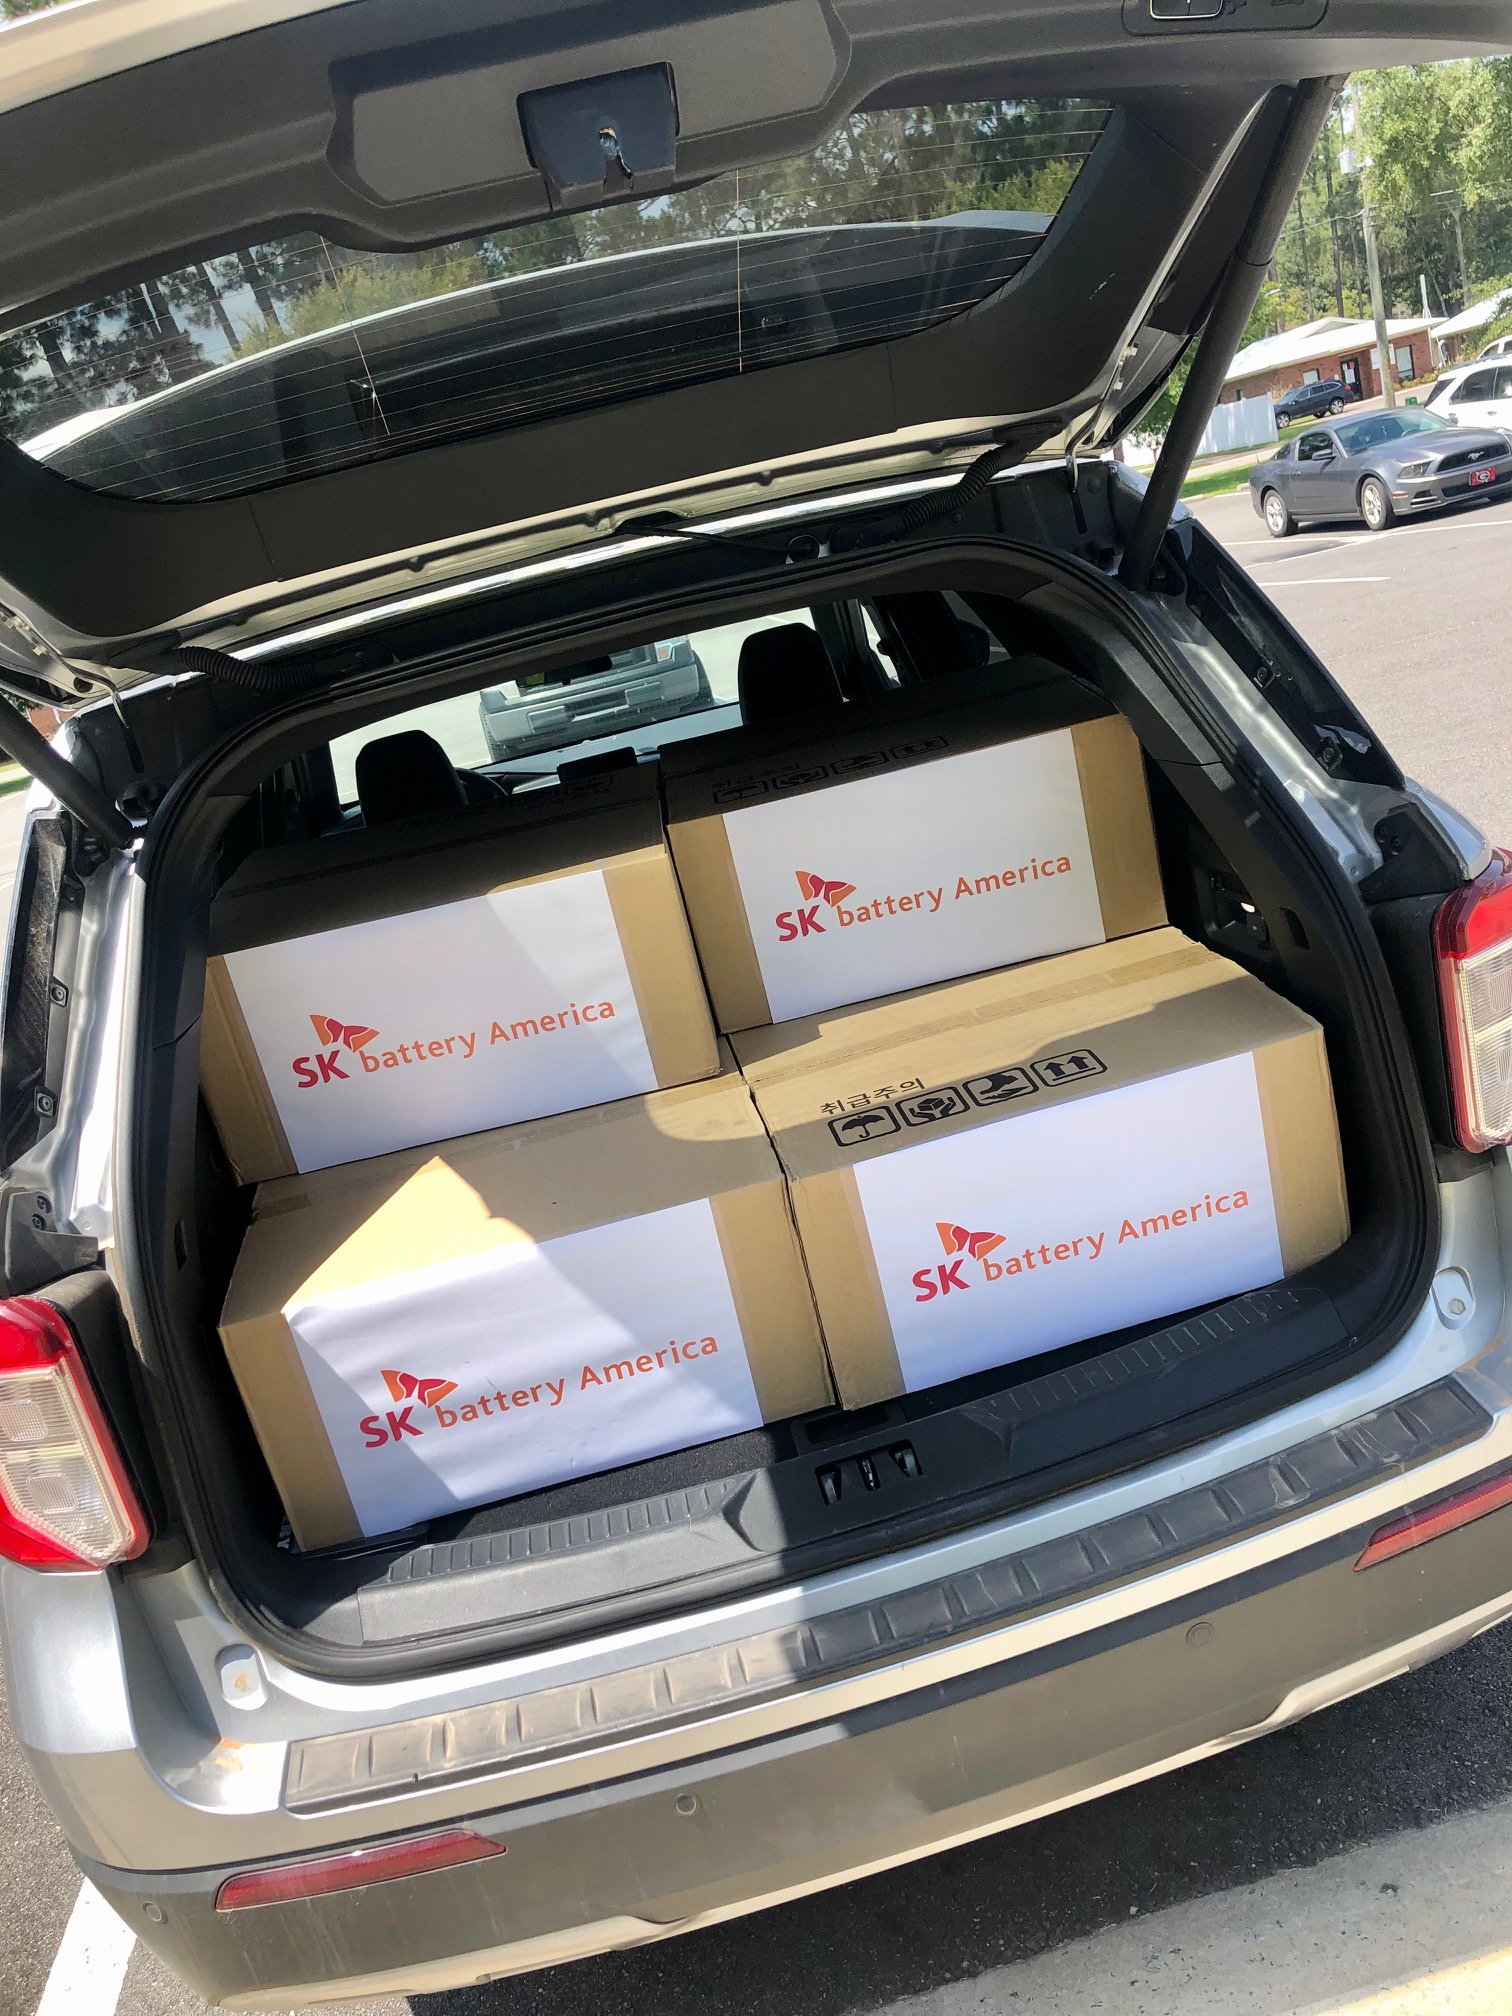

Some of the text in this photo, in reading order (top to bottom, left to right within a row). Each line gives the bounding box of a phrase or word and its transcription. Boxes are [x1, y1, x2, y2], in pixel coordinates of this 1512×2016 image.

[776, 856, 1072, 942] SK battery America
[293, 1001, 615, 1088] SK battery America
[820, 1077, 925, 1115] 취급주의
[913, 1190, 1250, 1302] SK battery America
[360, 1336, 719, 1447] SK battery America
